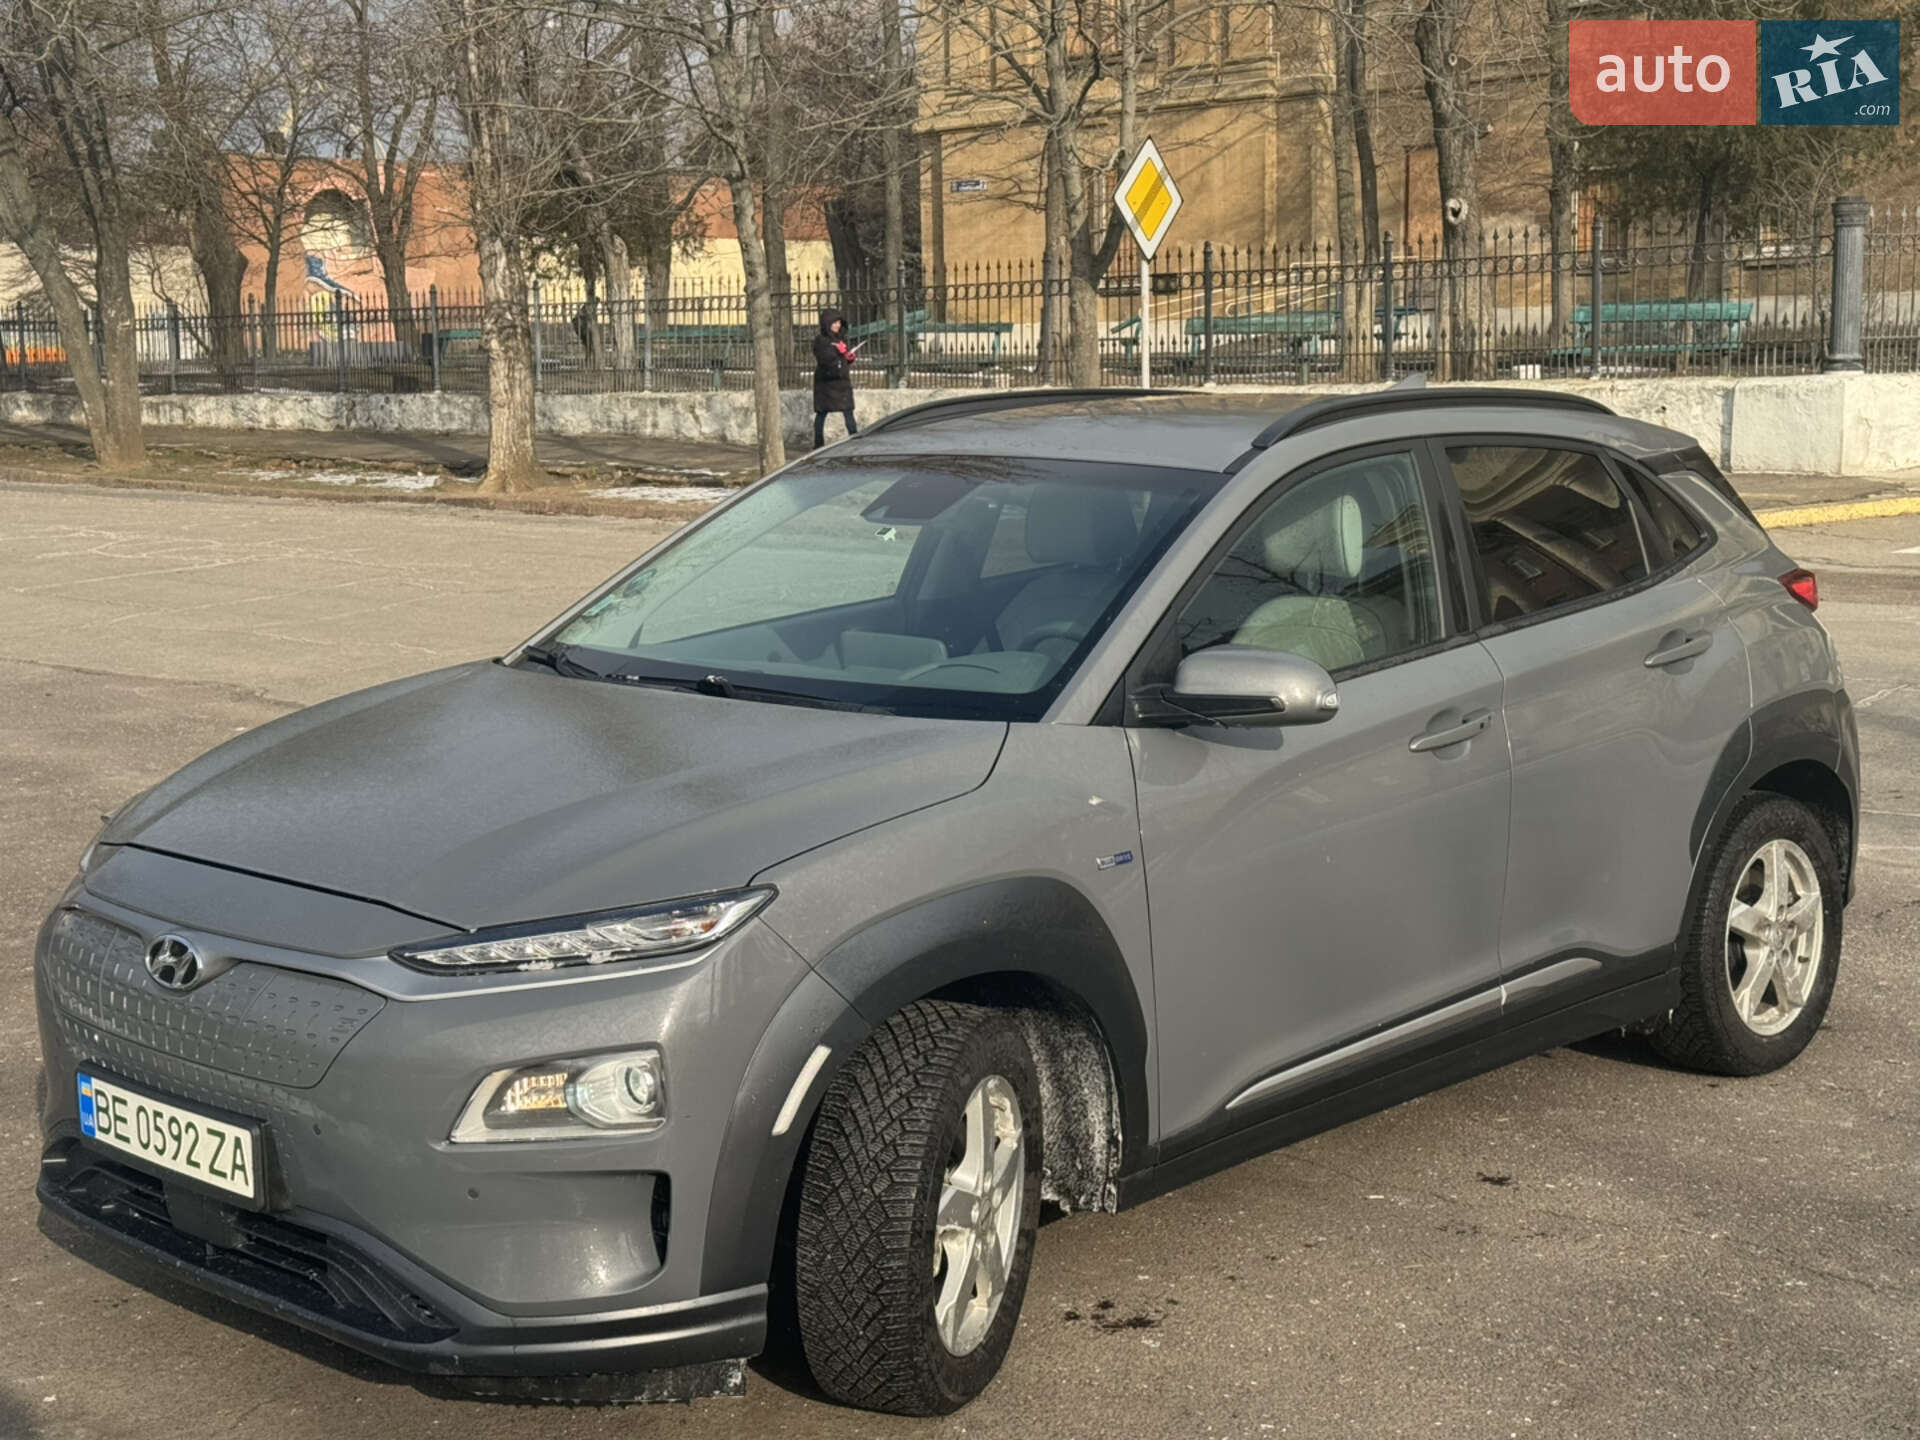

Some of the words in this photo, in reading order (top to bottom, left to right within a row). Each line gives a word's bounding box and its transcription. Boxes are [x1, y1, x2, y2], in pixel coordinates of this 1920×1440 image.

[94, 1088, 131, 1144] BE
[136, 1104, 201, 1169] 0592
[206, 1127, 249, 1186] ZA
